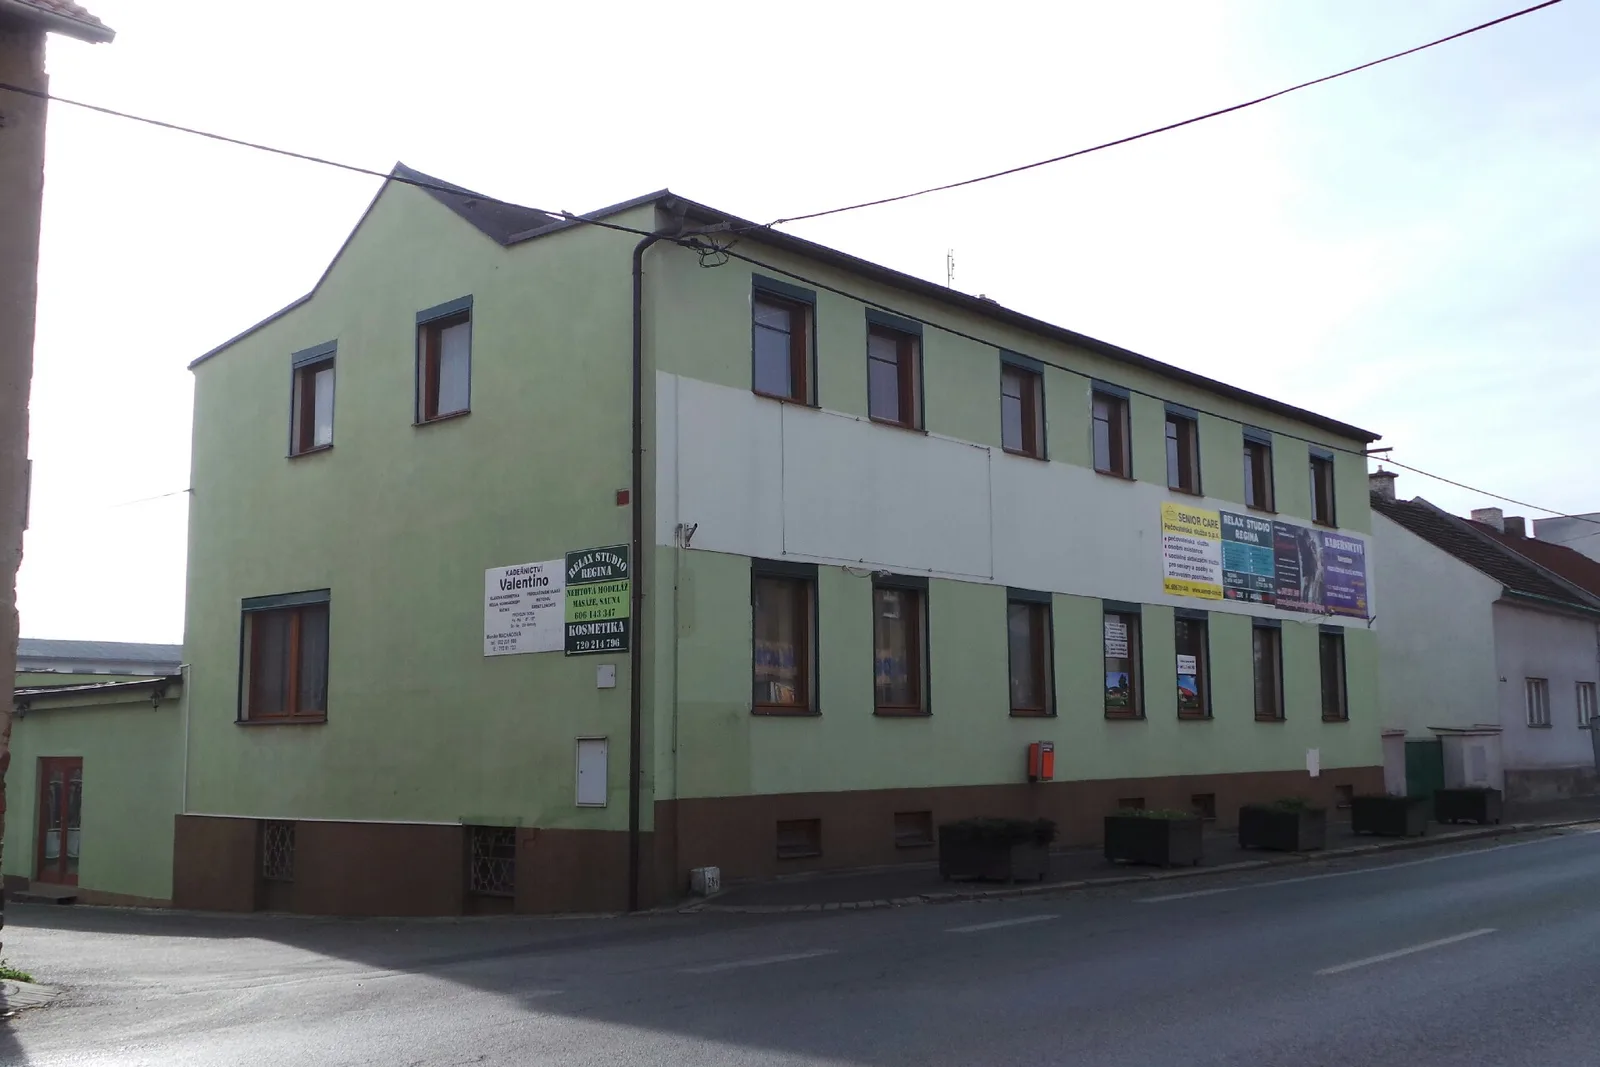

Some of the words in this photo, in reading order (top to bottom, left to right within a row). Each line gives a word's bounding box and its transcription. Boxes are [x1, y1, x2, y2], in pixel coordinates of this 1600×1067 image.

[1178, 512, 1201, 526] SENIOR
[1203, 518, 1219, 530] CARE
[1223, 514, 1244, 528] RELAX
[1246, 519, 1270, 533] STUDIO
[1235, 529, 1259, 543] REGINA
[568, 553, 594, 579] RELAX
[595, 551, 627, 572] STUDIO
[581, 565, 612, 579] REGINA
[499, 574, 549, 591] Valentino
[566, 587, 597, 597] NEHTOVÁ
[598, 582, 628, 594] MODELÁŽ
[599, 596, 621, 605] SAUNA
[574, 611, 588, 620] 606
[589, 609, 601, 619] 143
[602, 608, 616, 618] 347
[568, 620, 625, 637] KOSMETIKA
[576, 640, 590, 650] 720
[590, 639, 604, 649] 214
[606, 638, 620, 648] 796
